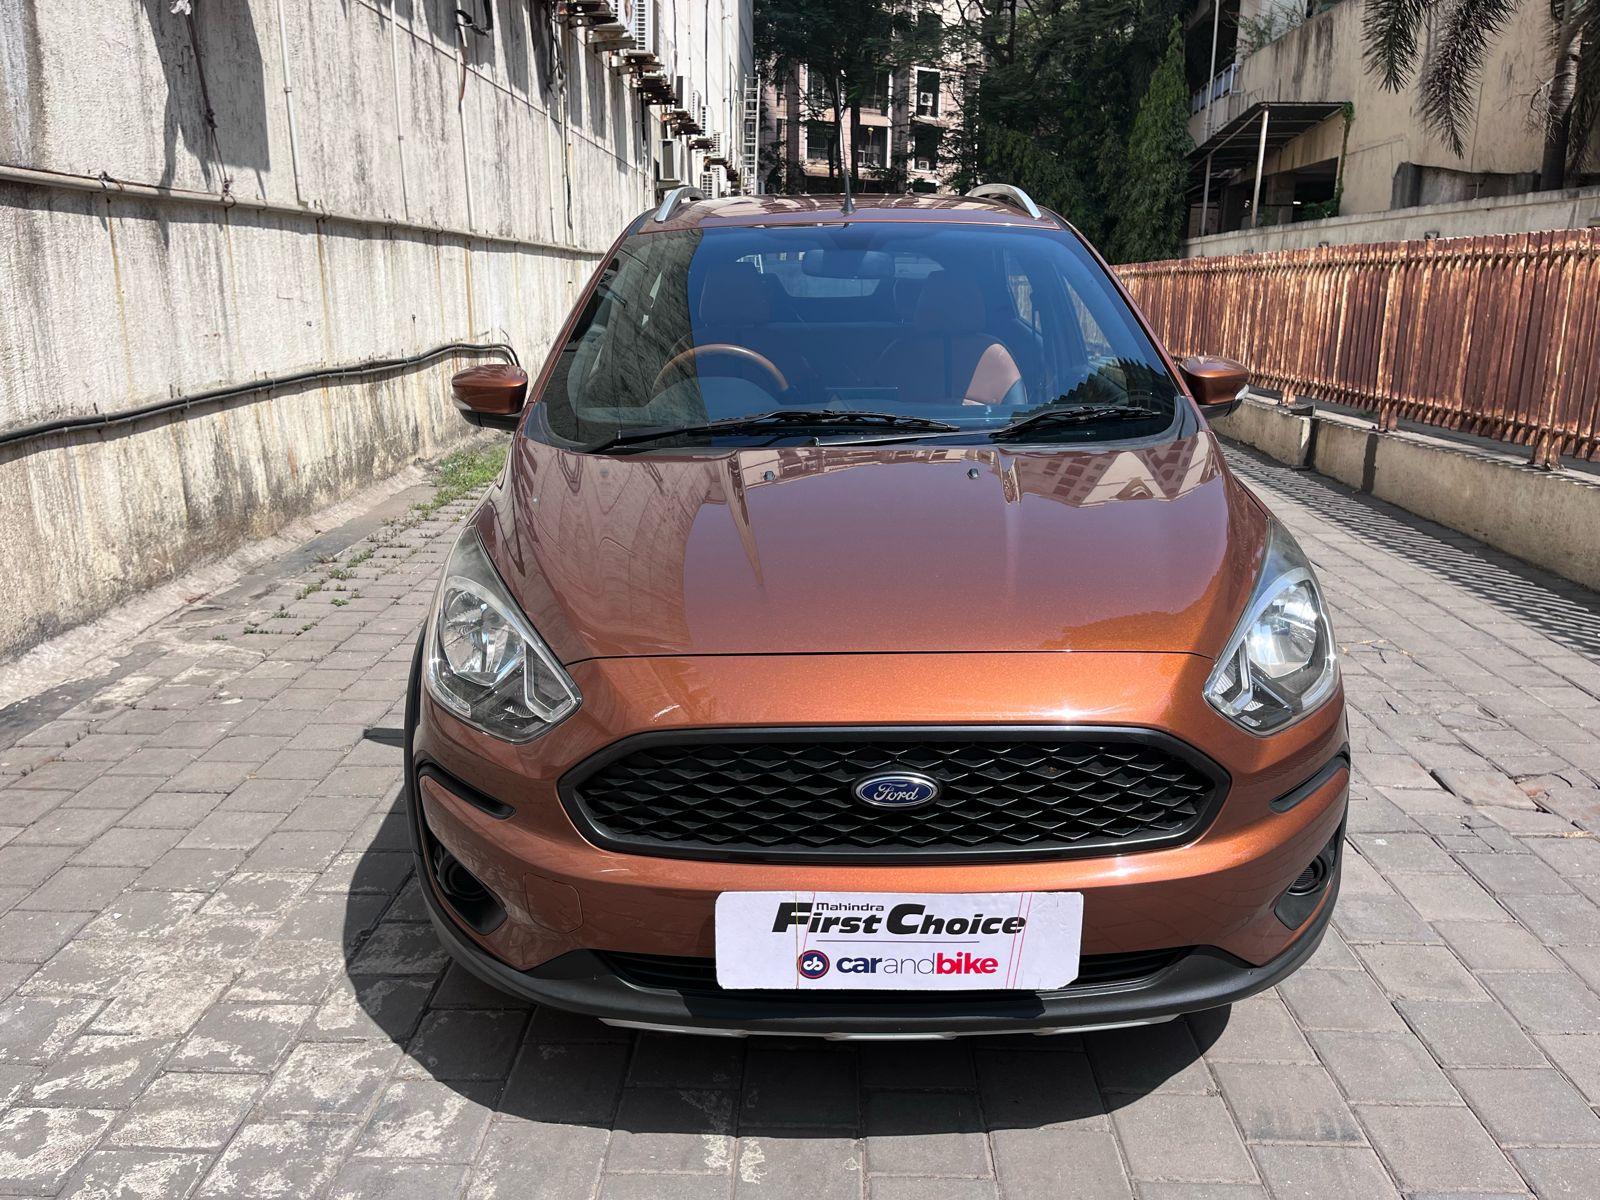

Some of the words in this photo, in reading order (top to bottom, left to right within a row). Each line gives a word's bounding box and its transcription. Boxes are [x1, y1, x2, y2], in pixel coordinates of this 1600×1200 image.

[874, 783, 919, 801] Ford
[816, 902, 884, 912] Mahindra
[772, 902, 883, 934] First
[886, 903, 1026, 935] Choice
[836, 952, 998, 975] carandbike
